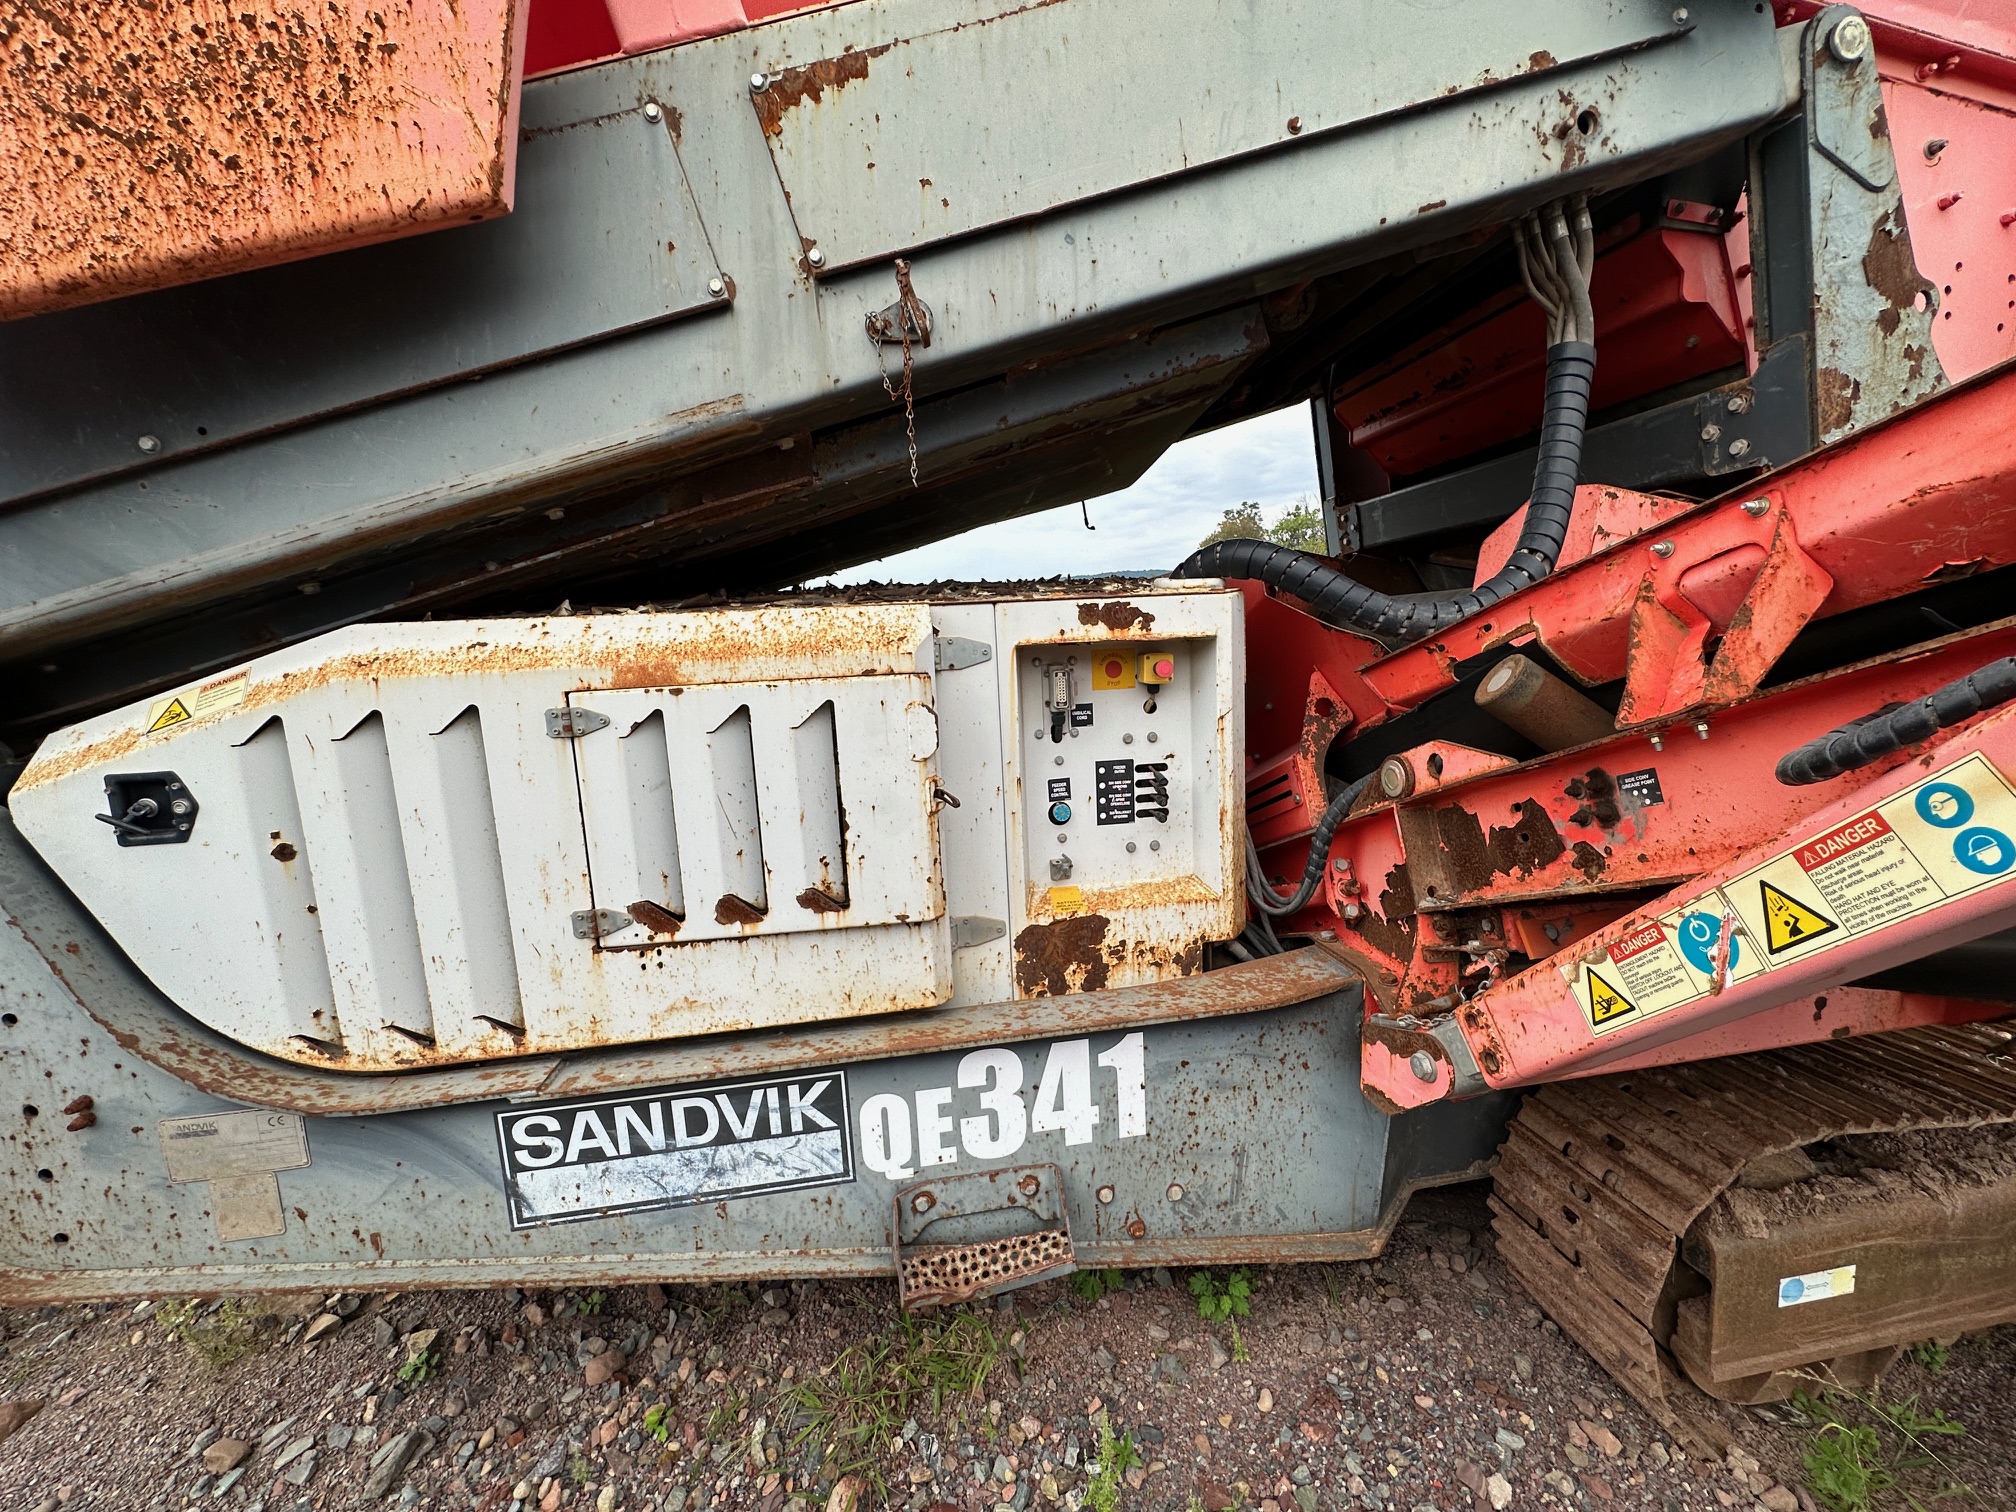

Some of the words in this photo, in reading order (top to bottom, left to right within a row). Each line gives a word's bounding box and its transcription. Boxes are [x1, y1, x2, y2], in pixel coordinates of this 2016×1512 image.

[1099, 653, 1128, 666] EMERGENCY
[210, 671, 247, 689] DANGER
[1622, 781, 1640, 789] GREASE
[1815, 818, 1882, 858] DANGER
[1810, 863, 1836, 878] FALLING
[1836, 849, 1868, 867] MATERIAL
[1867, 834, 1895, 851] HAZARD
[1824, 872, 1834, 881] not
[1834, 866, 1847, 877] walk
[1847, 862, 1860, 871] near
[1861, 849, 1884, 864] material
[1821, 875, 1847, 891] discharge
[1847, 869, 1864, 880] areas
[1824, 888, 1838, 898] Risk
[1838, 884, 1844, 892] of
[1844, 875, 1865, 889] serious
[1864, 869, 1880, 880] head
[1881, 862, 1898, 874] injury
[1830, 894, 1846, 904] death
[1834, 898, 1852, 910] HARD
[1852, 892, 1866, 903] HAT
[1866, 886, 1881, 897] AND
[1881, 880, 1896, 890] EYE
[1838, 895, 1880, 916] PROTECTION
[1880, 889, 1895, 899] must
[1896, 885, 1905, 893] be
[1905, 879, 1922, 889] worn
[1844, 915, 1852, 923] all
[1852, 908, 1868, 920] times
[1868, 902, 1884, 913] when
[1884, 893, 1908, 910] working
[1915, 886, 1927, 894] the
[1849, 918, 1868, 930] vicinity
[1869, 915, 1876, 923] of
[1875, 910, 1886, 920] the
[1886, 901, 1912, 916] machine
[1620, 928, 1661, 955] DANGER
[1618, 953, 1649, 971] ENTANGLEMENT
[1649, 946, 1665, 956] HAZARD
[1636, 961, 1646, 969] reach
[1625, 971, 1640, 981] conveyor
[1640, 972, 1652, 980] serious
[1648, 979, 1664, 989] machine
[1654, 984, 1671, 993] removing
[859, 1032, 1148, 1180] QE341
[173, 1121, 217, 1132] ANDVIK
[511, 1078, 840, 1169] SANDVIK
